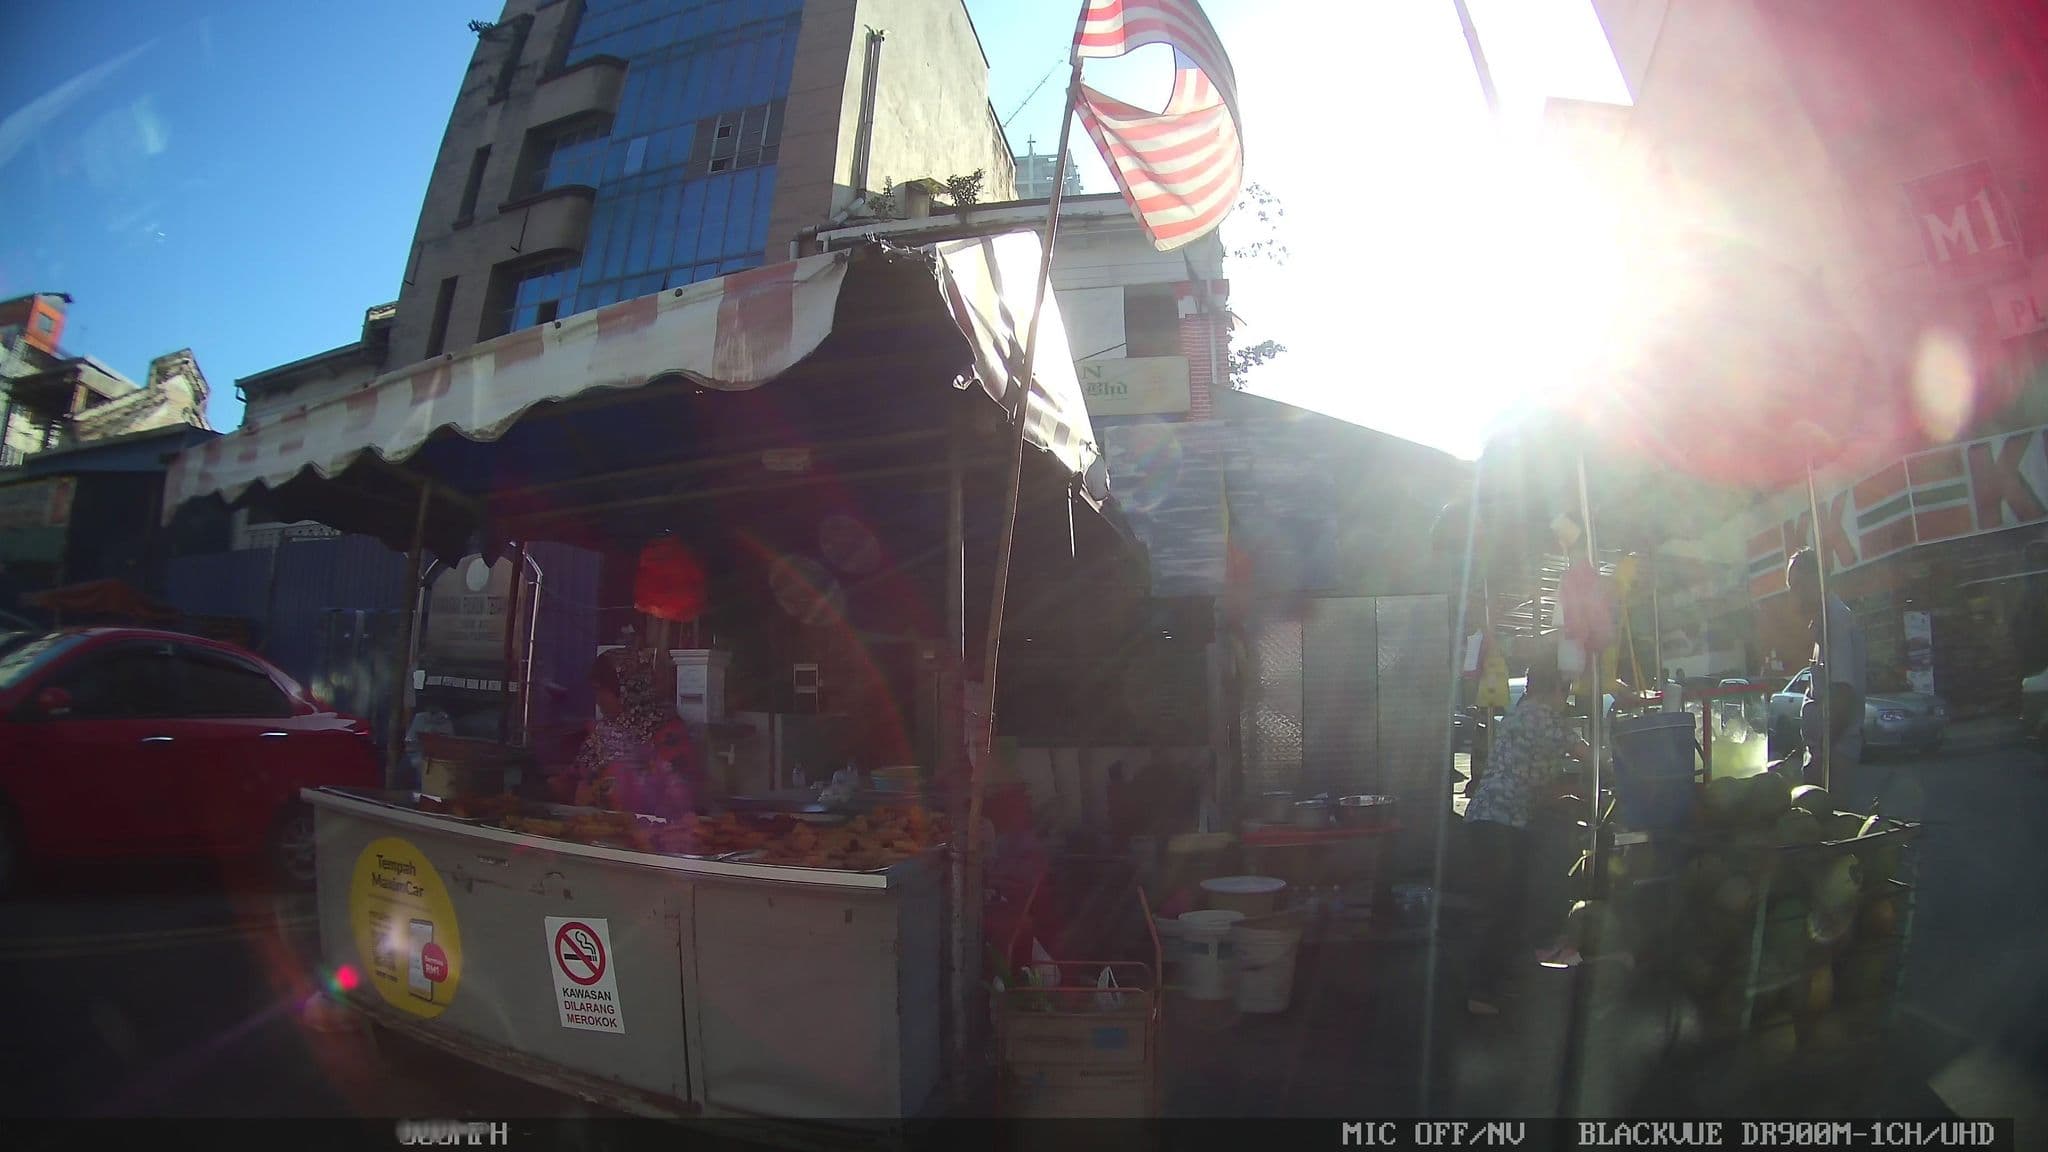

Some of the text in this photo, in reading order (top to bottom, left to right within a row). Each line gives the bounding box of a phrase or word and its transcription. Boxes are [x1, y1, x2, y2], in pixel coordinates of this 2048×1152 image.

[376, 854, 416, 876] Tempah
[562, 988, 611, 1000] KAWASAN
[564, 1000, 615, 1014] DILARANG
[567, 1014, 617, 1028] MEROKOK
